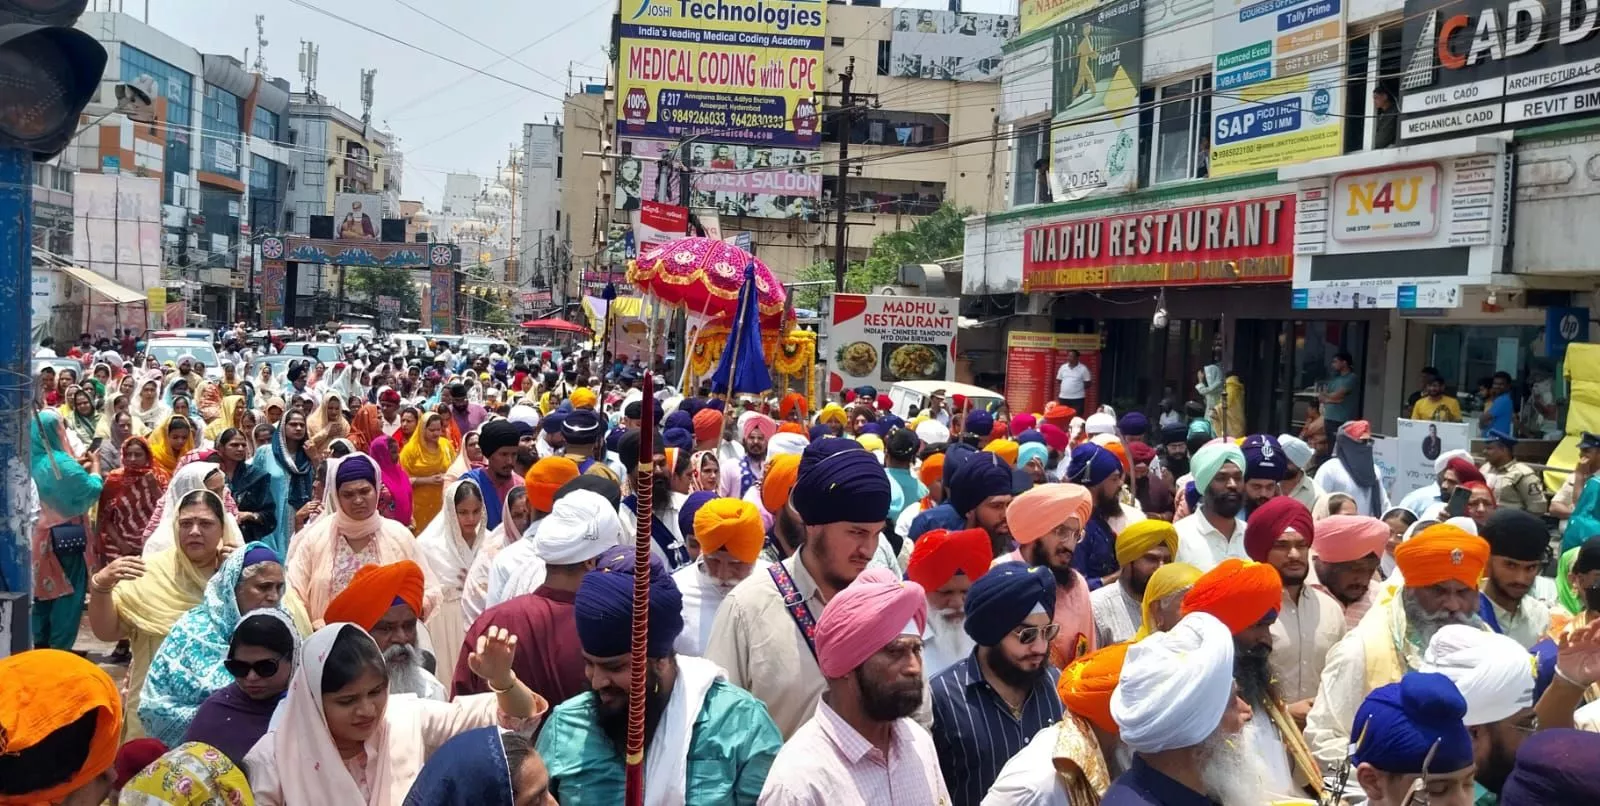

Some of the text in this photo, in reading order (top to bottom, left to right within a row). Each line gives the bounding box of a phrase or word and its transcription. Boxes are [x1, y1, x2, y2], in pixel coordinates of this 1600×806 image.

[648, 5, 672, 17] JOSHI
[679, 0, 822, 30] Technologies
[1241, 4, 1274, 20] COURSES
[1286, 3, 1331, 24] Tally Prime
[638, 27, 811, 47] India's leading Medical Coding Academy
[1438, 0, 1546, 68] CAD
[1098, 47, 1120, 65] teach
[1218, 44, 1271, 68] Advanced Excel
[629, 46, 817, 91] MEDICAL CODING with CPC
[1508, 65, 1591, 90] ARCHITECTURAL
[627, 94, 647, 110] 100%
[667, 92, 681, 106] 217
[1314, 94, 1328, 104] ISO
[1425, 87, 1479, 105] CIVIL CADD
[1523, 92, 1600, 117] REVIT BIM
[1256, 107, 1275, 120] FICO
[1409, 110, 1493, 133] MECHANICAL CADD
[1217, 112, 1255, 139] SAP
[1262, 121, 1273, 132] SD
[1279, 117, 1293, 128] MM
[751, 171, 820, 191] SALOON
[1346, 176, 1423, 216] N4U
[1030, 200, 1283, 262] MADHU RESTAURANT
[883, 301, 936, 315] MADHU
[864, 313, 954, 329] RESTAURANT
[864, 327, 886, 335] INDIAN
[920, 329, 953, 337] TANDOORI
